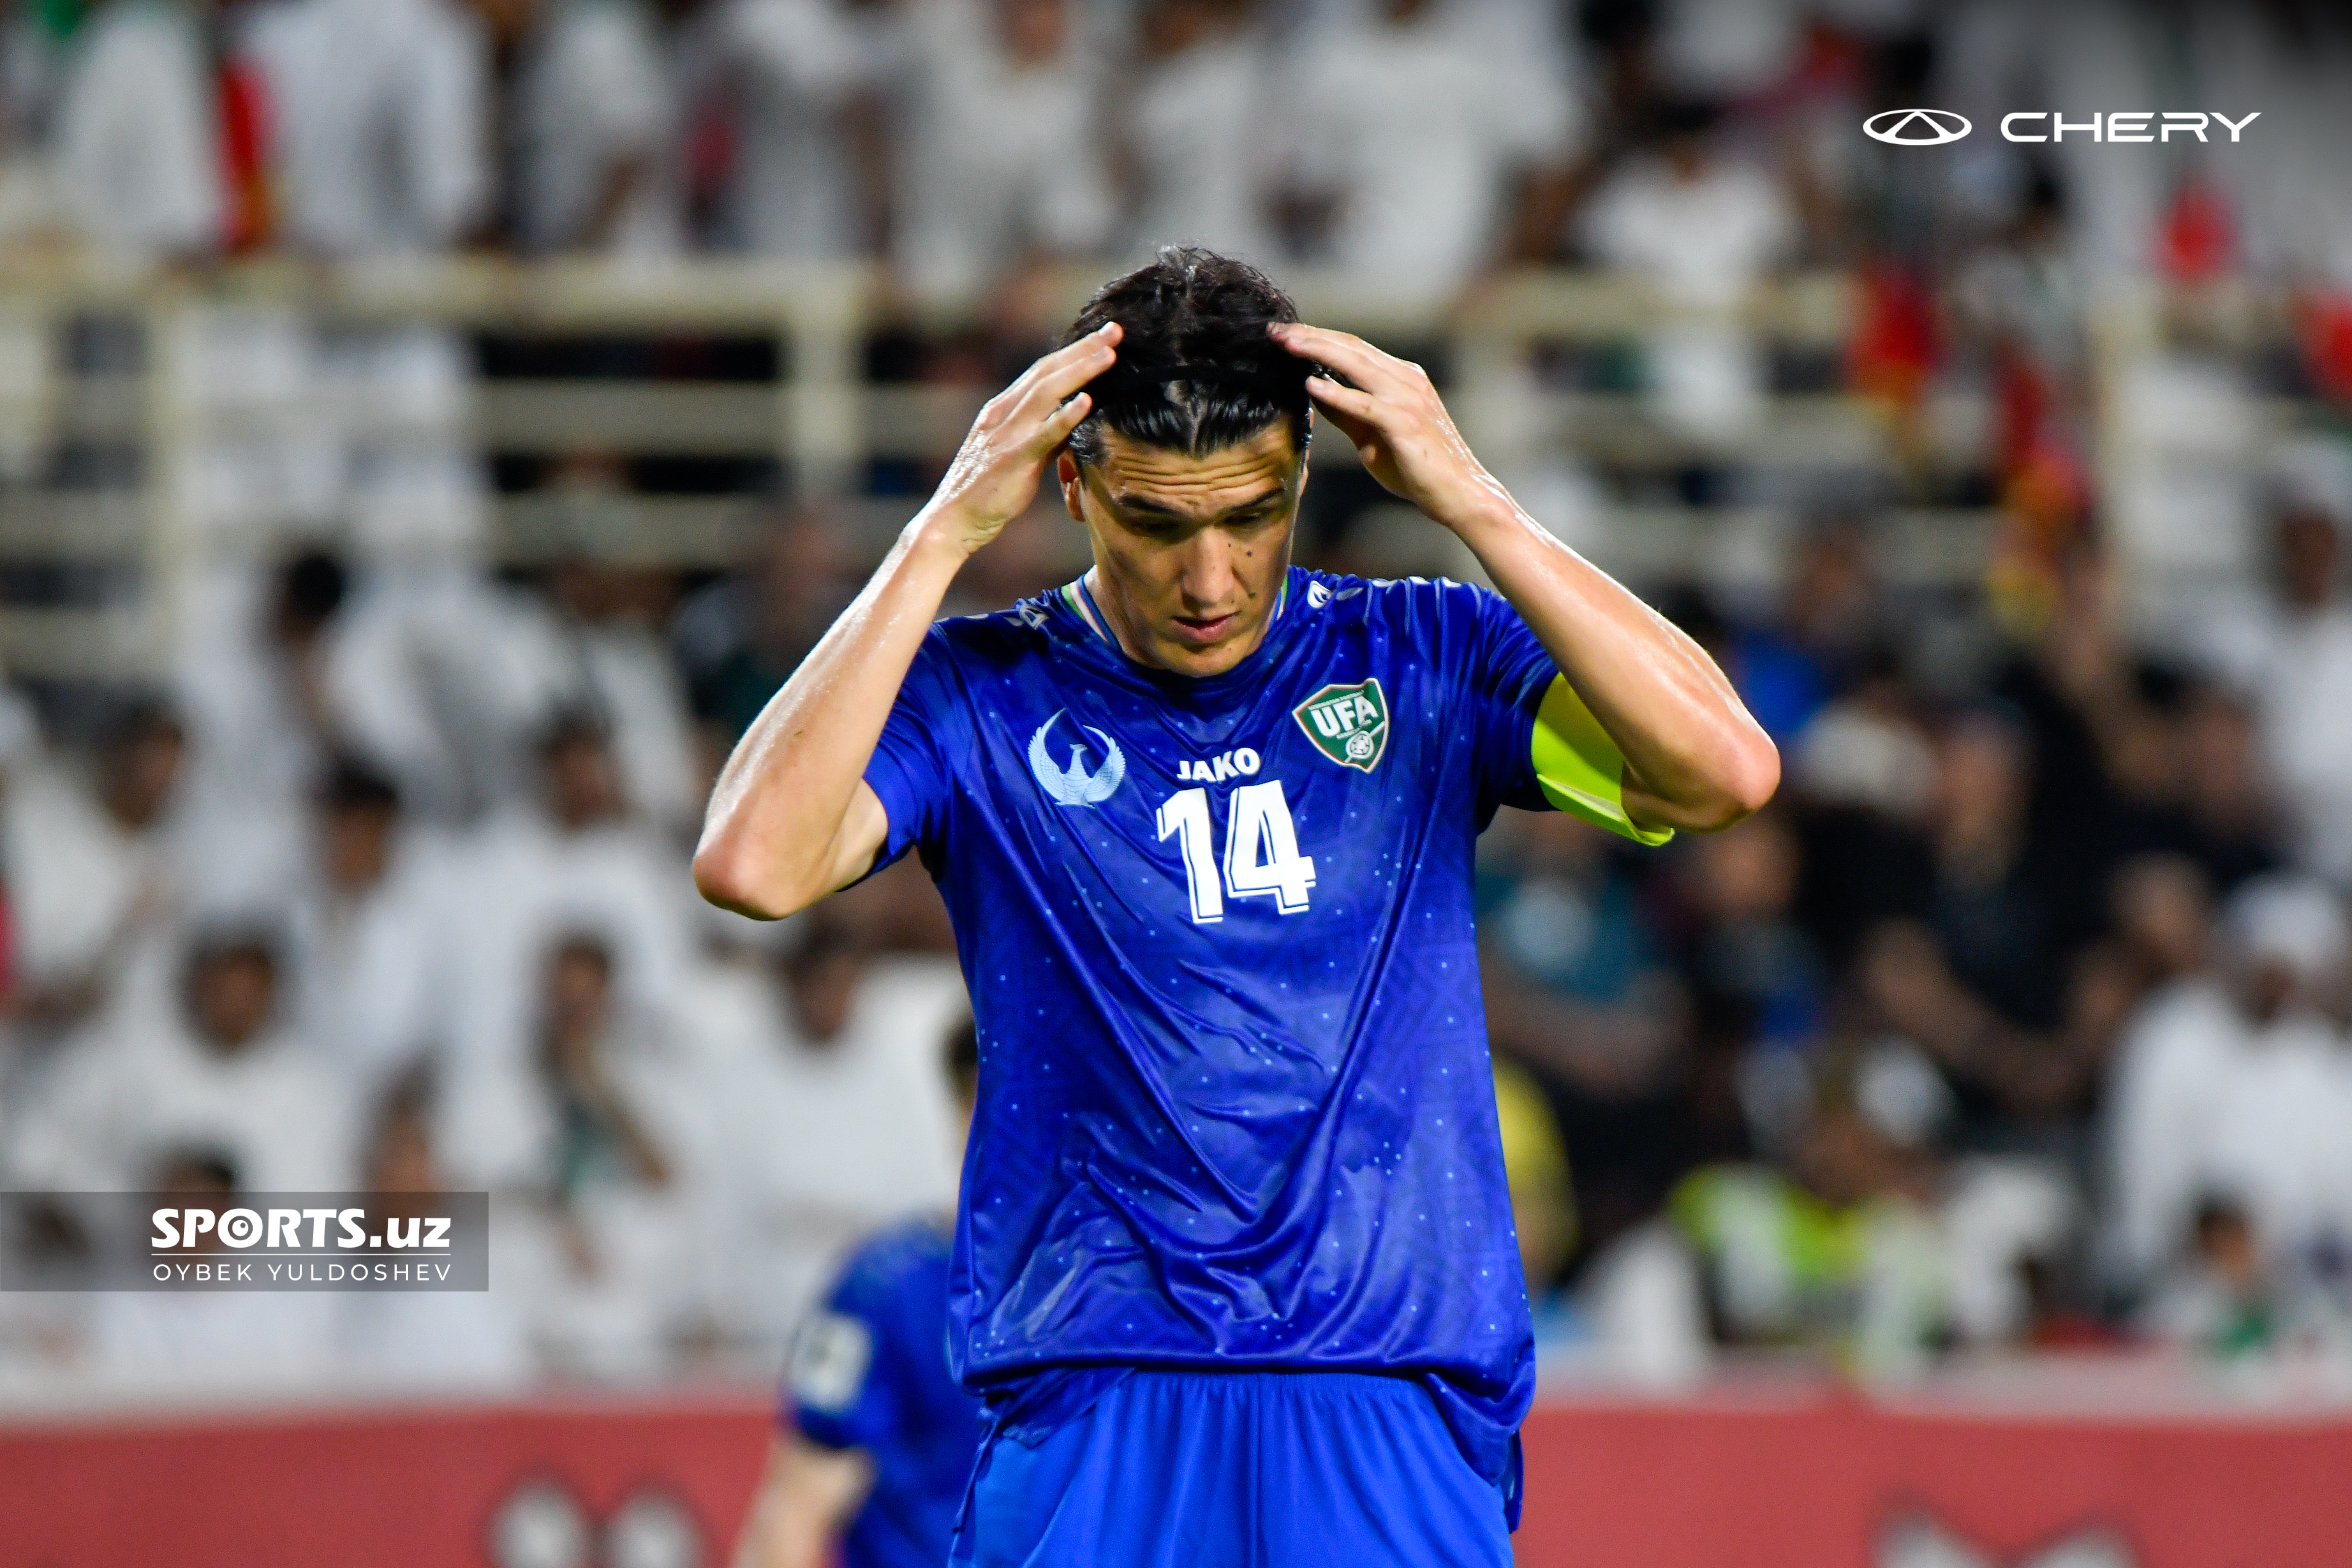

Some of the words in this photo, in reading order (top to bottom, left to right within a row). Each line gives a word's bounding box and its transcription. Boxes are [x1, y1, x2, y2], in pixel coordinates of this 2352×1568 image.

[1310, 695, 1378, 737] UFA
[1177, 747, 1260, 781] JAKO
[1156, 779, 1316, 923] 14
